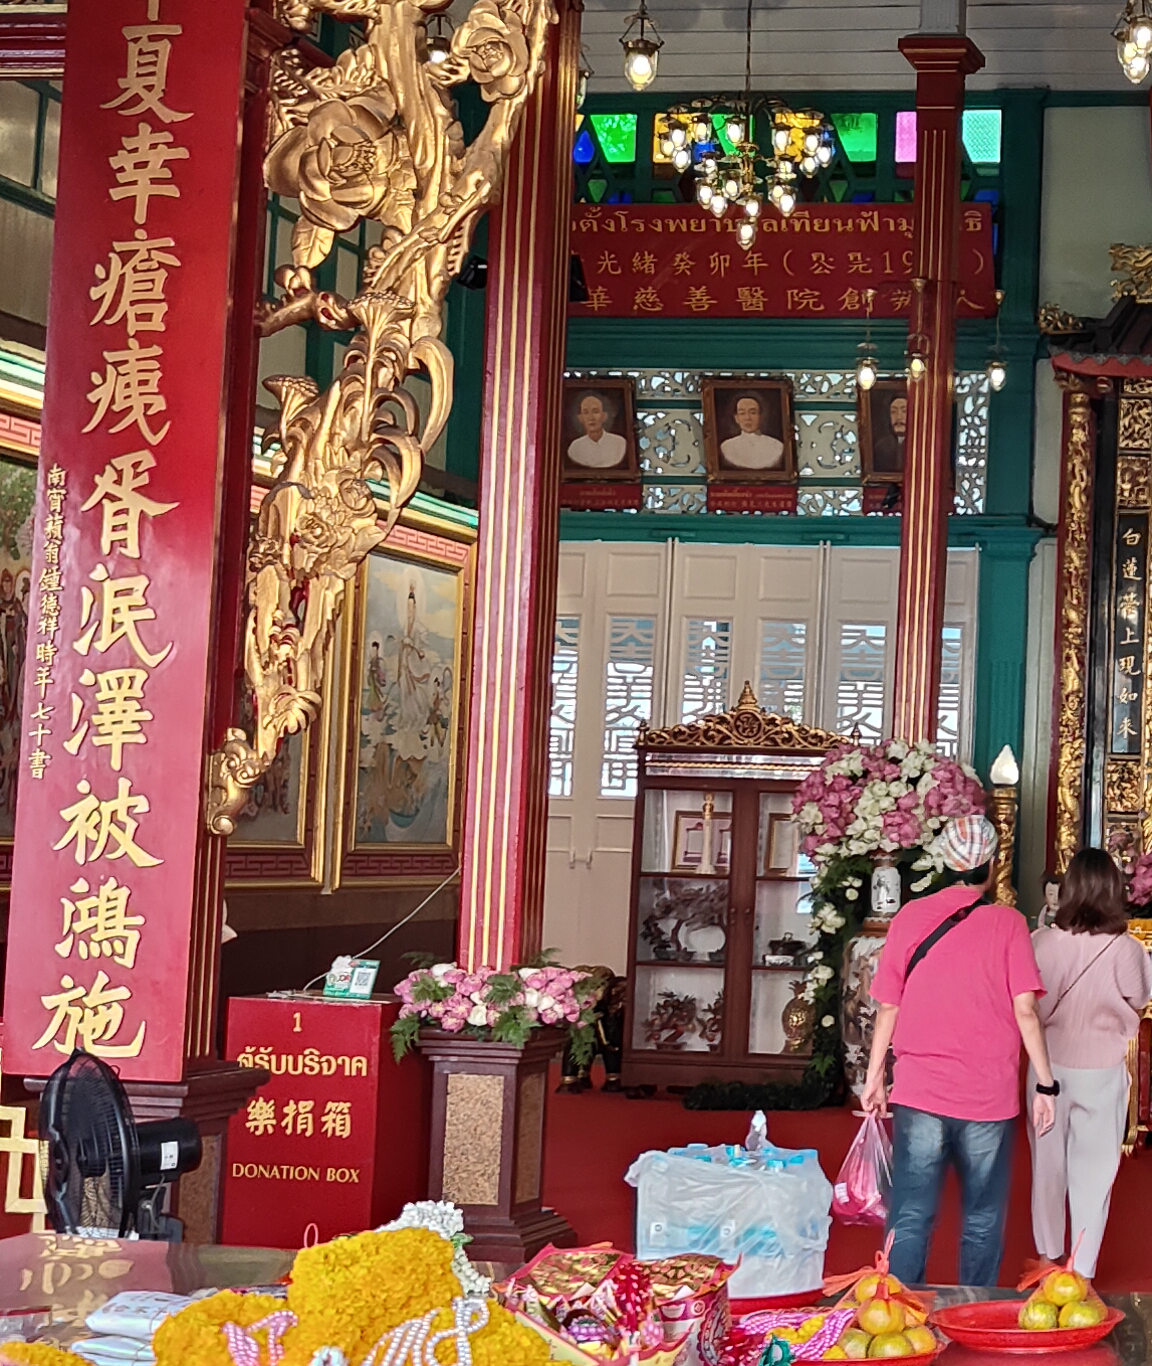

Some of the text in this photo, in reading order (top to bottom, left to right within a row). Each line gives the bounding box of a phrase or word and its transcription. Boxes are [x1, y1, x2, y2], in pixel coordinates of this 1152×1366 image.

[292, 1012, 302, 1032] 1
[237, 1045, 368, 1076] ต้รับบริจาค
[245, 1096, 352, 1139] 樂捐箱
[232, 1163, 361, 1183] DONATION BOX
